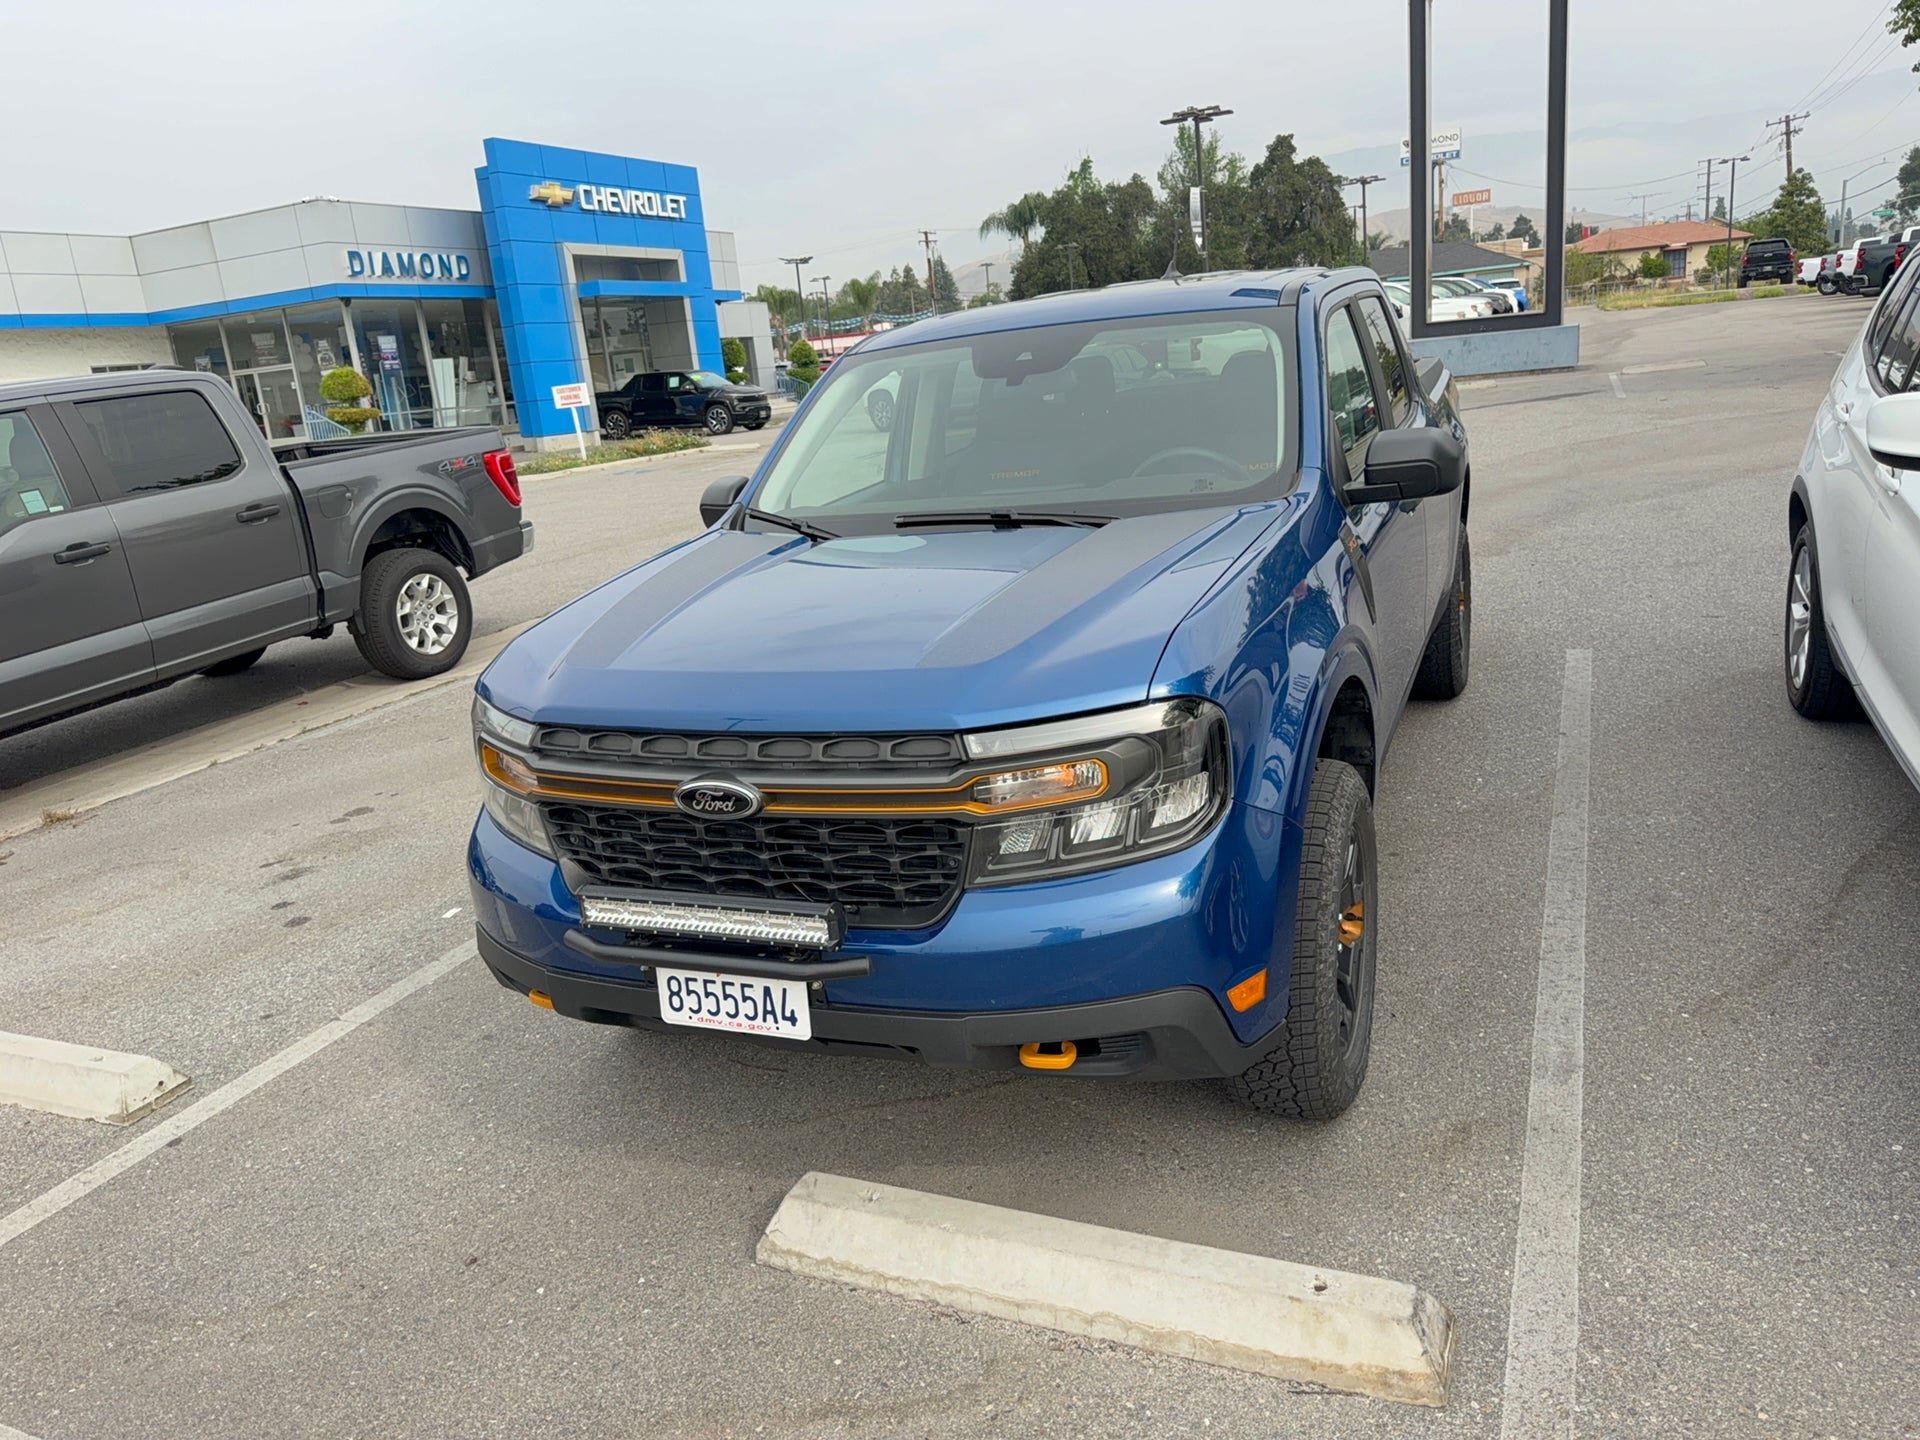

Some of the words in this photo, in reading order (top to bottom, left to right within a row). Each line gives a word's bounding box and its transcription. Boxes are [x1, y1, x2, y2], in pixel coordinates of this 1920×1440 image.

[1431, 133, 1459, 144] MOND
[577, 184, 686, 219] CHEVROLET
[1454, 191, 1489, 205] LIQUOR
[347, 250, 470, 280] DIAMOND
[989, 468, 1041, 481] TREMOR
[692, 789, 736, 812] Ford
[667, 975, 798, 1027] 85555A4
[697, 1016, 772, 1031] dmv.ca.gov
